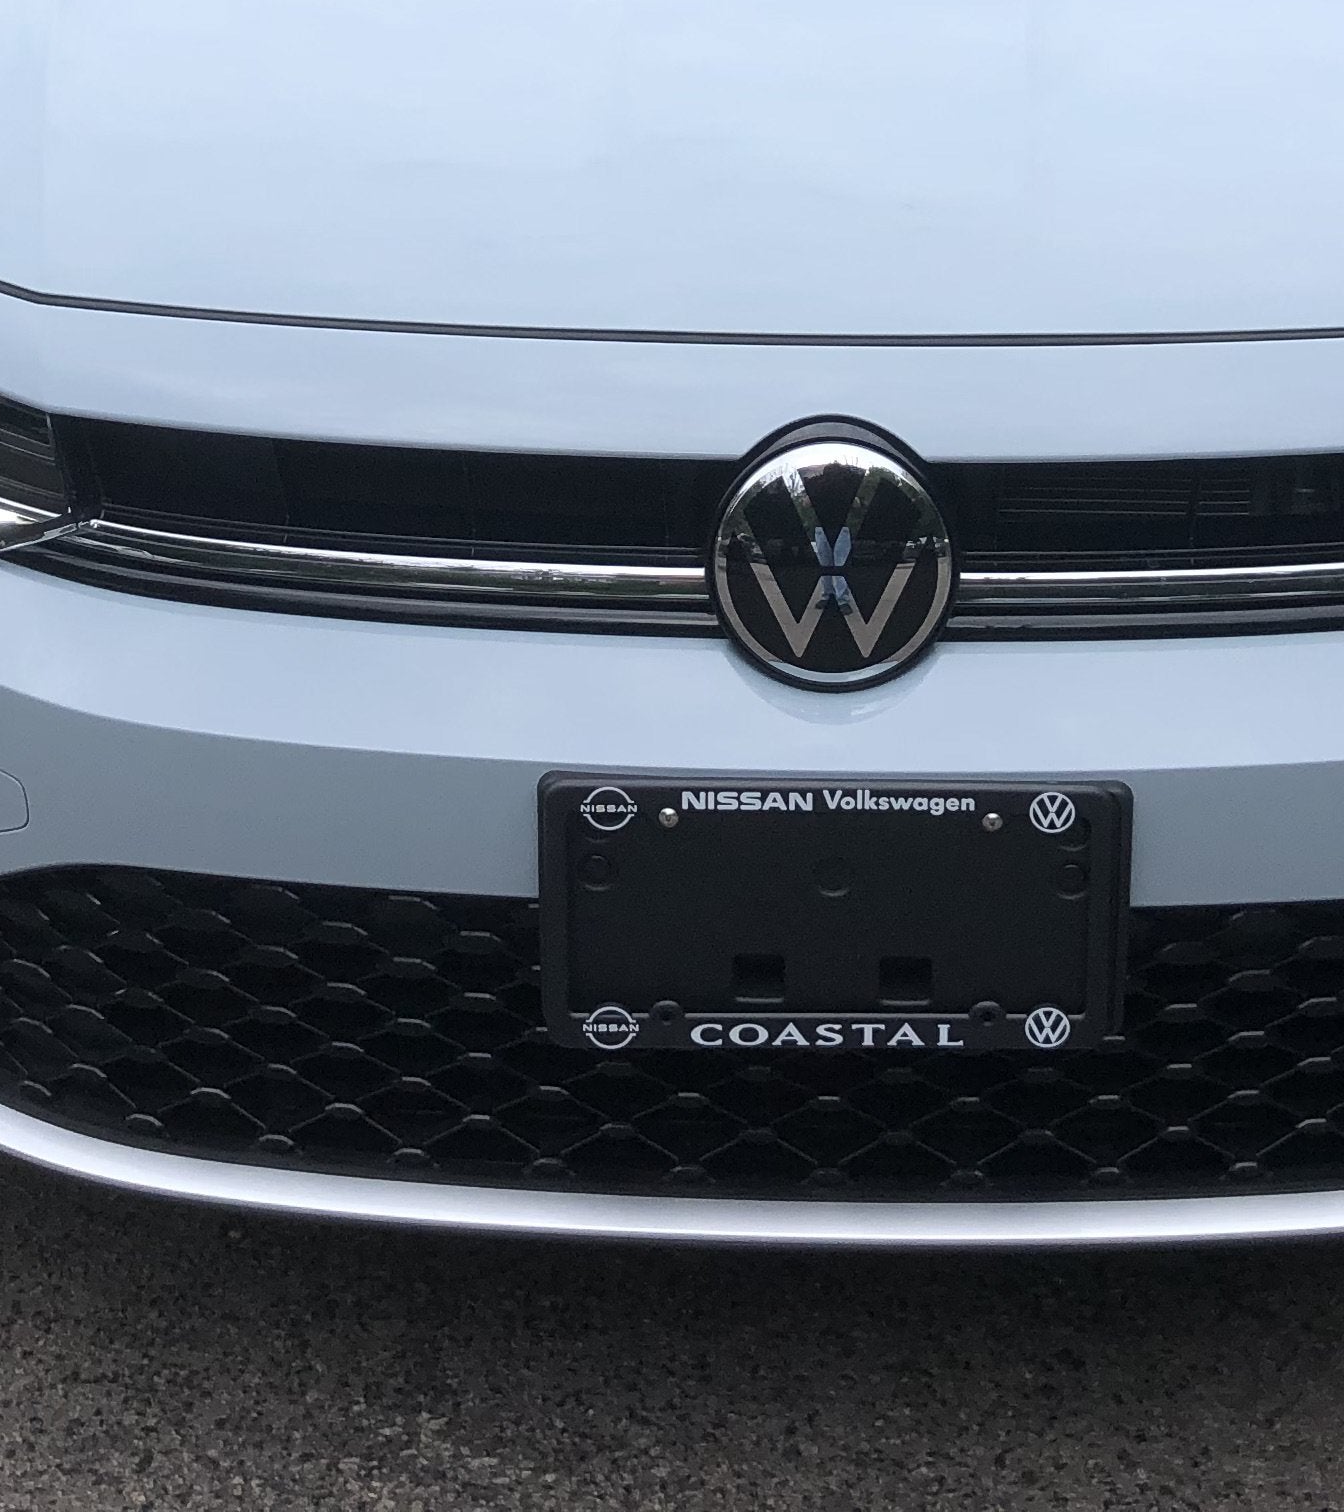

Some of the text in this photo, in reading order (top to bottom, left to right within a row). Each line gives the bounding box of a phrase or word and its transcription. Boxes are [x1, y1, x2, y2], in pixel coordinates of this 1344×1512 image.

[580, 803, 638, 814] NISSAN
[681, 789, 976, 816] NISSAN Volkswagen
[582, 1023, 640, 1033] NISSAN
[690, 1022, 964, 1046] COASTAL
